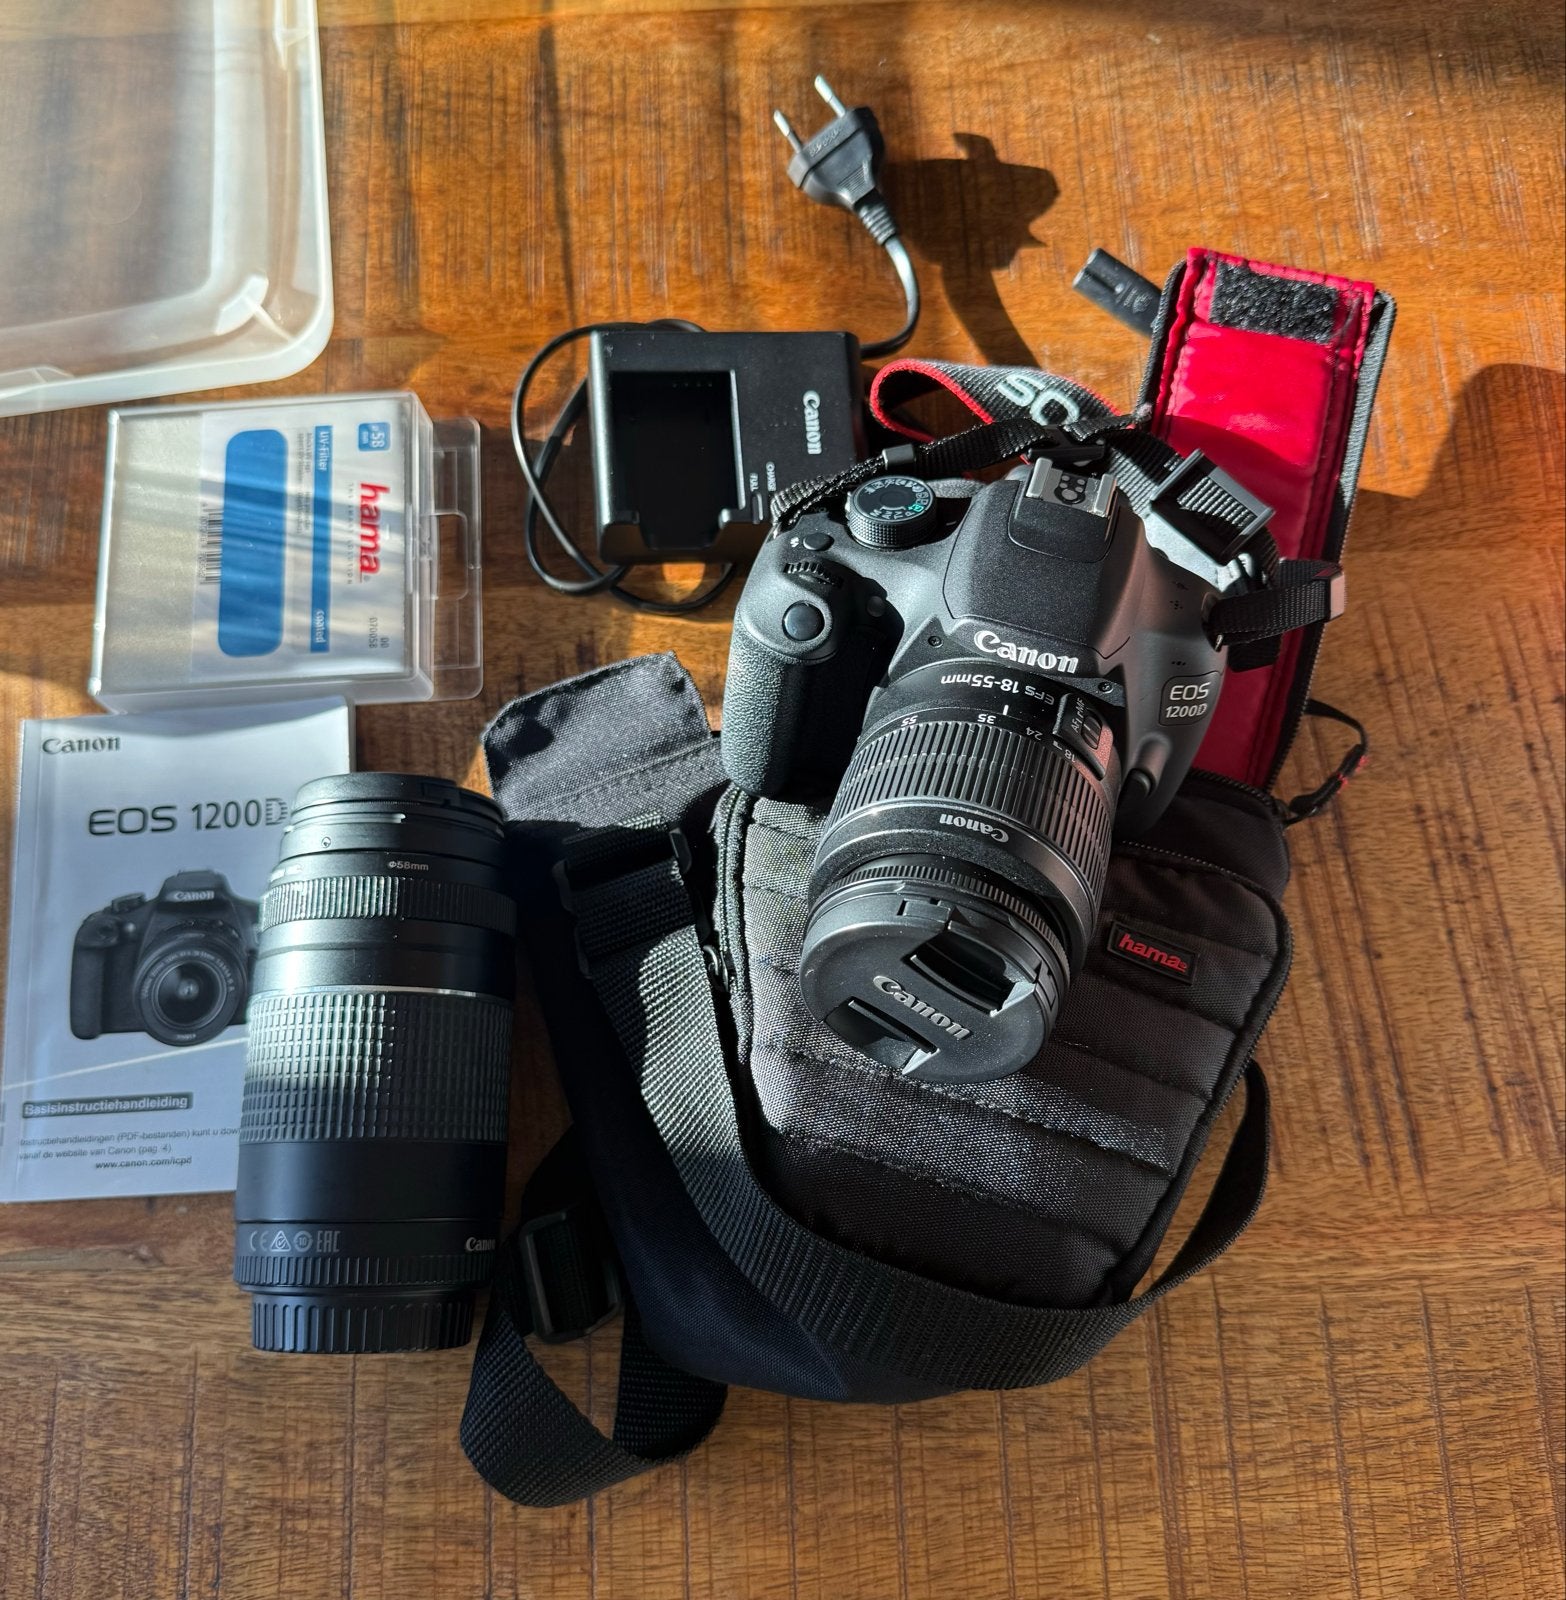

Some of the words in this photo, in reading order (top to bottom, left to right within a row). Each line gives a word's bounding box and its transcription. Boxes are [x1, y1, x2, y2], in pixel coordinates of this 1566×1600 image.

[802, 390, 823, 455] Canon
[317, 431, 330, 472] UV-Filter
[359, 482, 391, 576] hama
[315, 611, 327, 643] coated
[973, 630, 1079, 675] Canon
[940, 674, 1021, 694] 18-55mm
[1169, 682, 1210, 701] EOS
[977, 713, 997, 724] 35
[1164, 702, 1208, 721] 1200D
[899, 714, 919, 729] 55
[1024, 726, 1044, 741] 24
[42, 735, 121, 755] Canon
[1063, 749, 1077, 763] 18
[87, 804, 178, 837] EOS
[191, 797, 289, 831] 1200D
[939, 813, 1009, 843] Canon
[173, 890, 215, 901] Canon
[1118, 933, 1187, 972] hama
[873, 974, 974, 1040] Canon
[25, 1096, 188, 1115] Basisinstructiehandleiding
[117, 1129, 190, 1144] (PDF-bestanden)
[192, 1128, 211, 1137] kunt
[43, 1150, 53, 1158] de
[55, 1148, 87, 1158] website
[89, 1148, 106, 1156] van
[107, 1146, 136, 1155] Canon
[95, 1156, 193, 1169] www.canon.com/icpd
